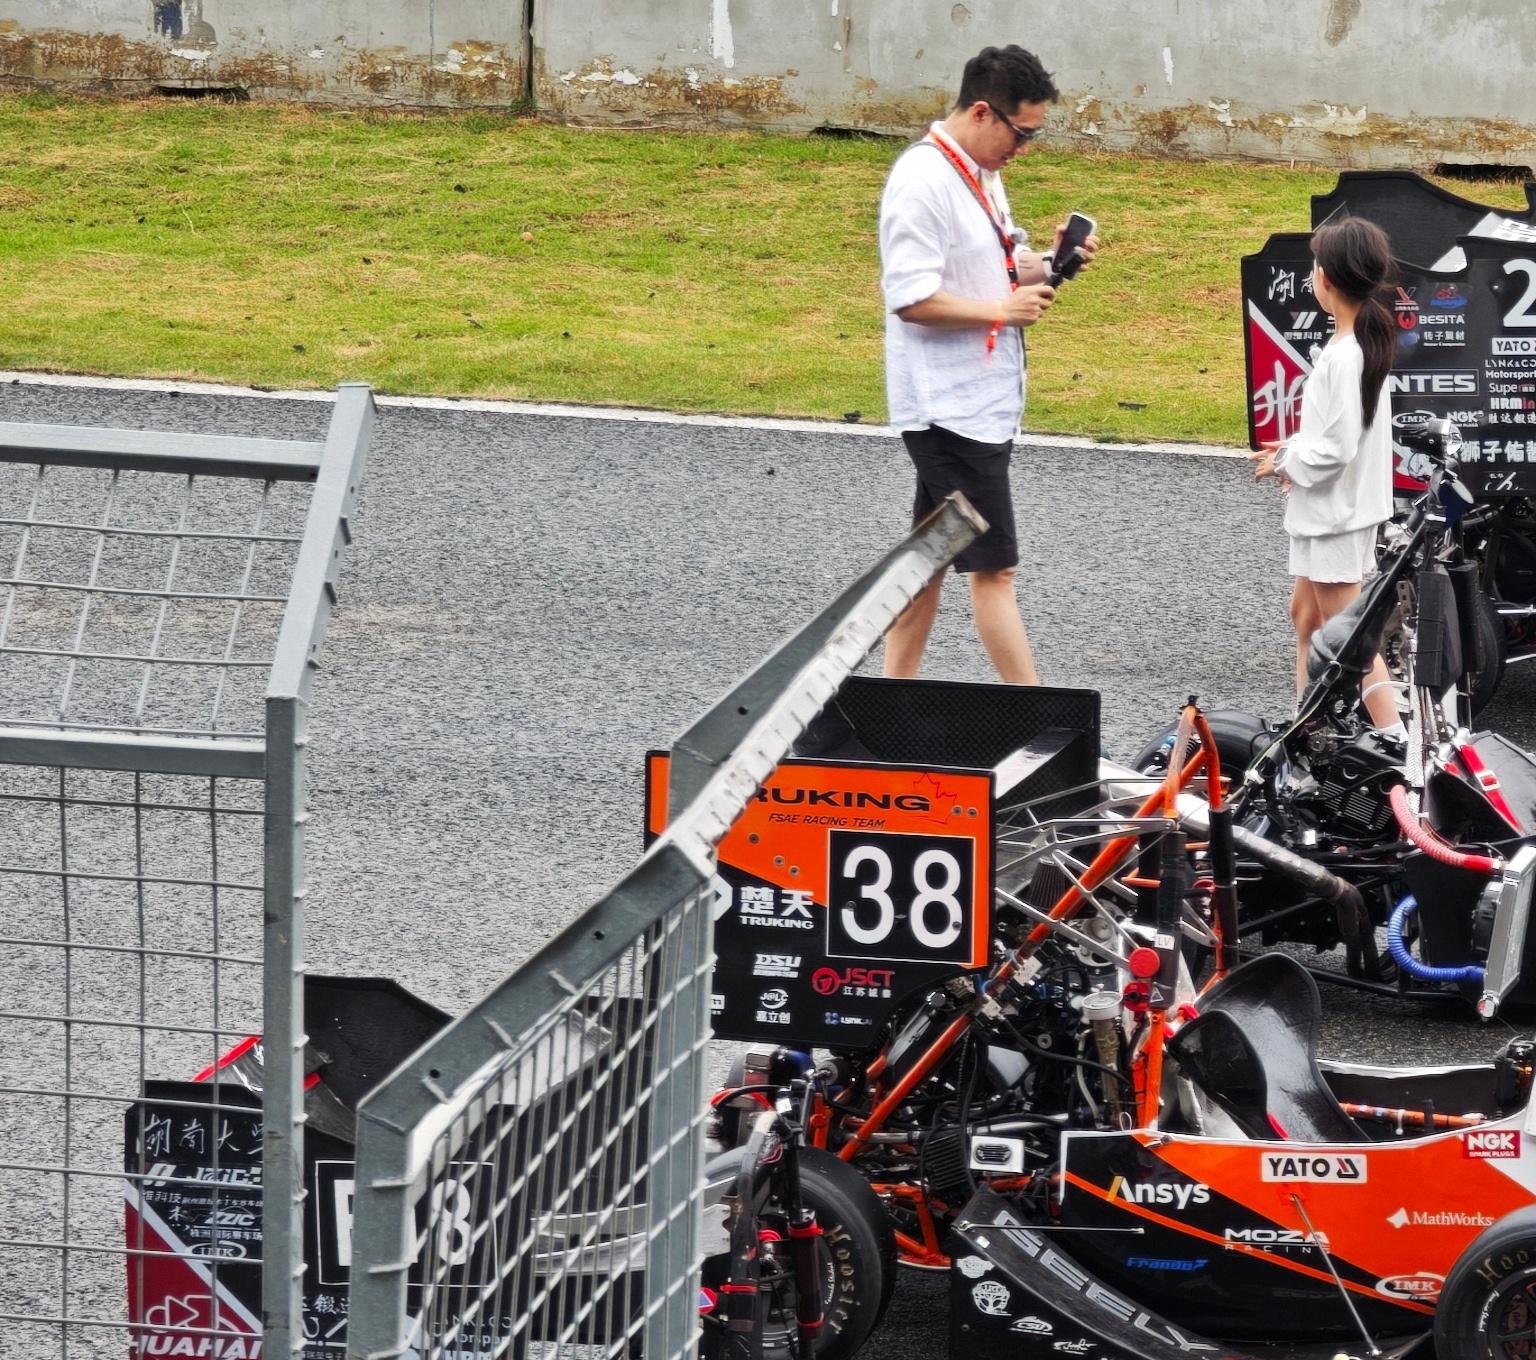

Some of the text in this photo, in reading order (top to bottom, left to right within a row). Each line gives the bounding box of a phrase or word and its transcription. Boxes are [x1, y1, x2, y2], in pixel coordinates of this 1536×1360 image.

[1419, 314, 1465, 325] BESITA
[1496, 341, 1531, 352] YATO
[1447, 411, 1478, 423] NGK
[768, 813, 886, 829] FSAE RACING TEAM
[740, 886, 814, 918] 楚天
[841, 845, 964, 949] 38
[739, 915, 815, 930] TRUKING
[840, 967, 896, 988] JSCT
[1467, 1133, 1516, 1150] NGK
[1268, 1157, 1331, 1178] YATO
[1107, 1175, 1210, 1210] Ansys
[1412, 1211, 1494, 1227] MathWorks
[1224, 1228, 1331, 1245] MOZA
[993, 1209, 1222, 1352] GEELY
[1393, 1279, 1437, 1292] IMK
